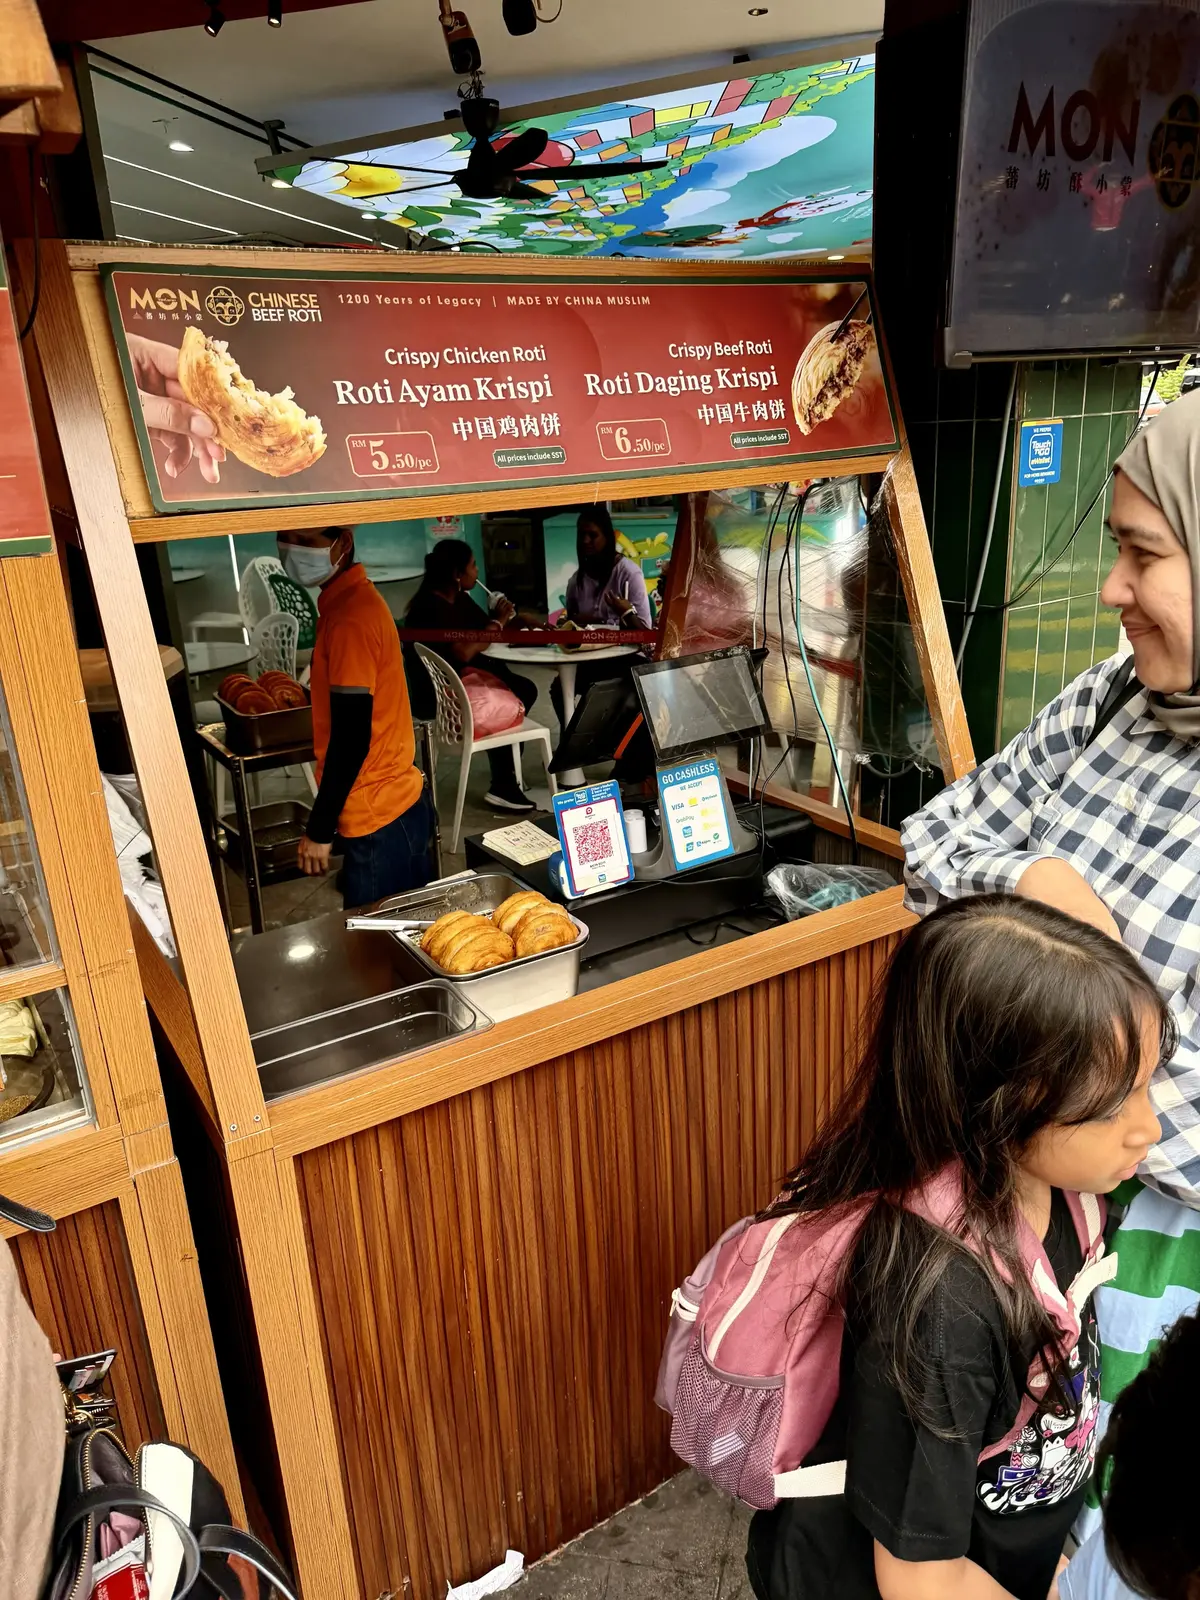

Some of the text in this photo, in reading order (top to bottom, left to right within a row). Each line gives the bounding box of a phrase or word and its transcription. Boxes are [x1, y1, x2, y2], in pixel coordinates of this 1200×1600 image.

[1007, 79, 1141, 167] MON
[130, 286, 201, 311] MON
[248, 292, 320, 309] CHINESE
[338, 294, 370, 304] 1200
[376, 294, 413, 305] Years
[419, 295, 432, 305] of
[437, 295, 481, 307] Legacy
[506, 296, 541, 306] MADE
[546, 296, 560, 305] BY
[565, 296, 602, 306] CHINA
[607, 296, 651, 306] MUSLIM
[252, 308, 323, 322] BEEF ROTI
[384, 344, 546, 369] Crispy Chicken Roti
[668, 339, 773, 360] Crispy Beef Roti
[584, 365, 779, 397] Roti Daging Krispi
[332, 373, 554, 408] Roti Ayam Krispi
[697, 398, 786, 426] 中国牛肉饼
[452, 412, 562, 442] 中国鸡肉饼
[600, 426, 613, 434] RM
[351, 439, 367, 448] RM
[741, 435, 757, 444] prices
[757, 434, 778, 443] include
[1032, 440, 1051, 449] Touch
[497, 451, 563, 464] All prices include SST
[582, 632, 605, 640] MON
[662, 763, 715, 785] GO CASHLESS
[688, 781, 703, 789] ACCEPT
[671, 803, 685, 811] VISA
[675, 815, 695, 824] GrabPay
